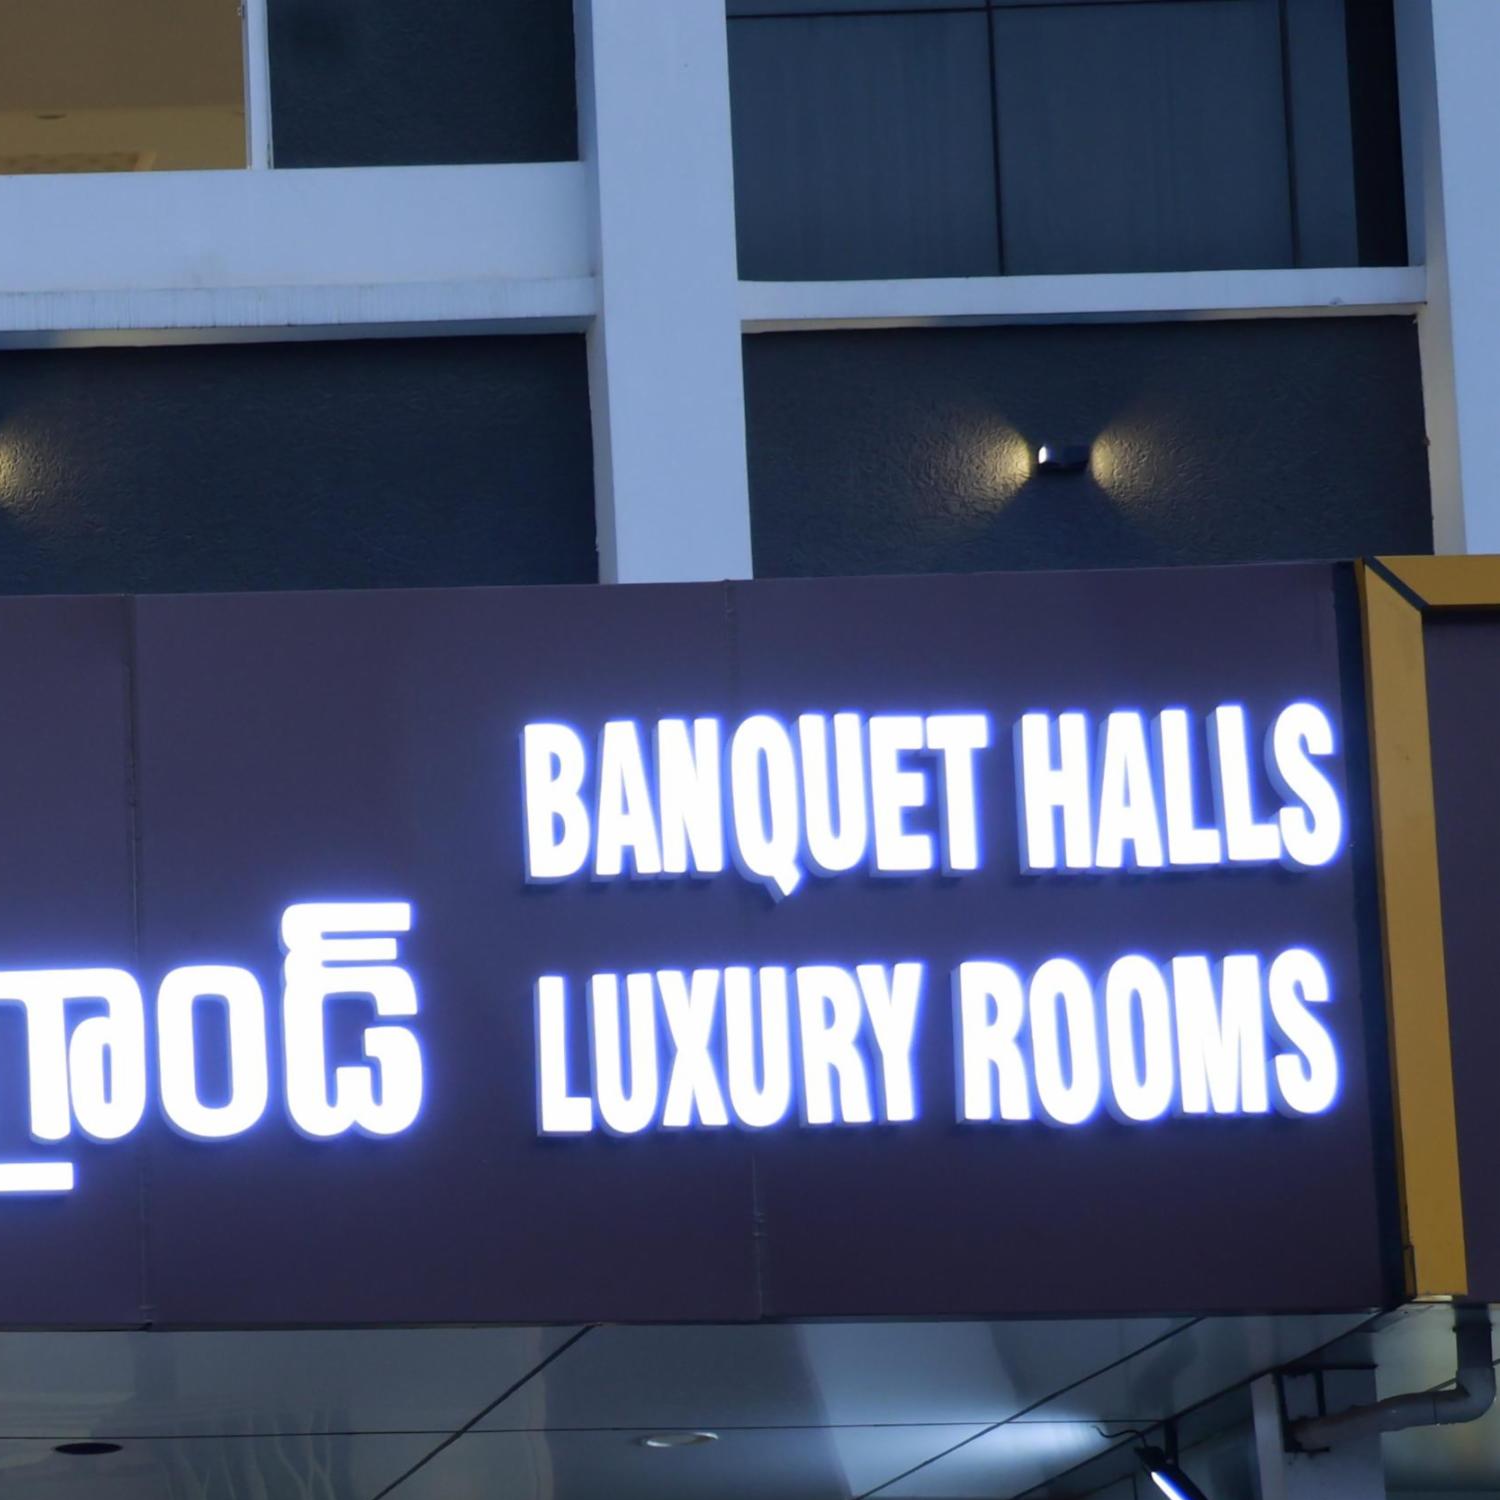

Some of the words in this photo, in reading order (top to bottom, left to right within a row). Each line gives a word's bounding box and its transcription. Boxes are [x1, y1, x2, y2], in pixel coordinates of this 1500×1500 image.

[521, 711, 992, 899] BANQUET
[1016, 701, 1344, 873] HALLS
[534, 960, 926, 1138] LUXURY
[956, 946, 1340, 1128] ROOMS
